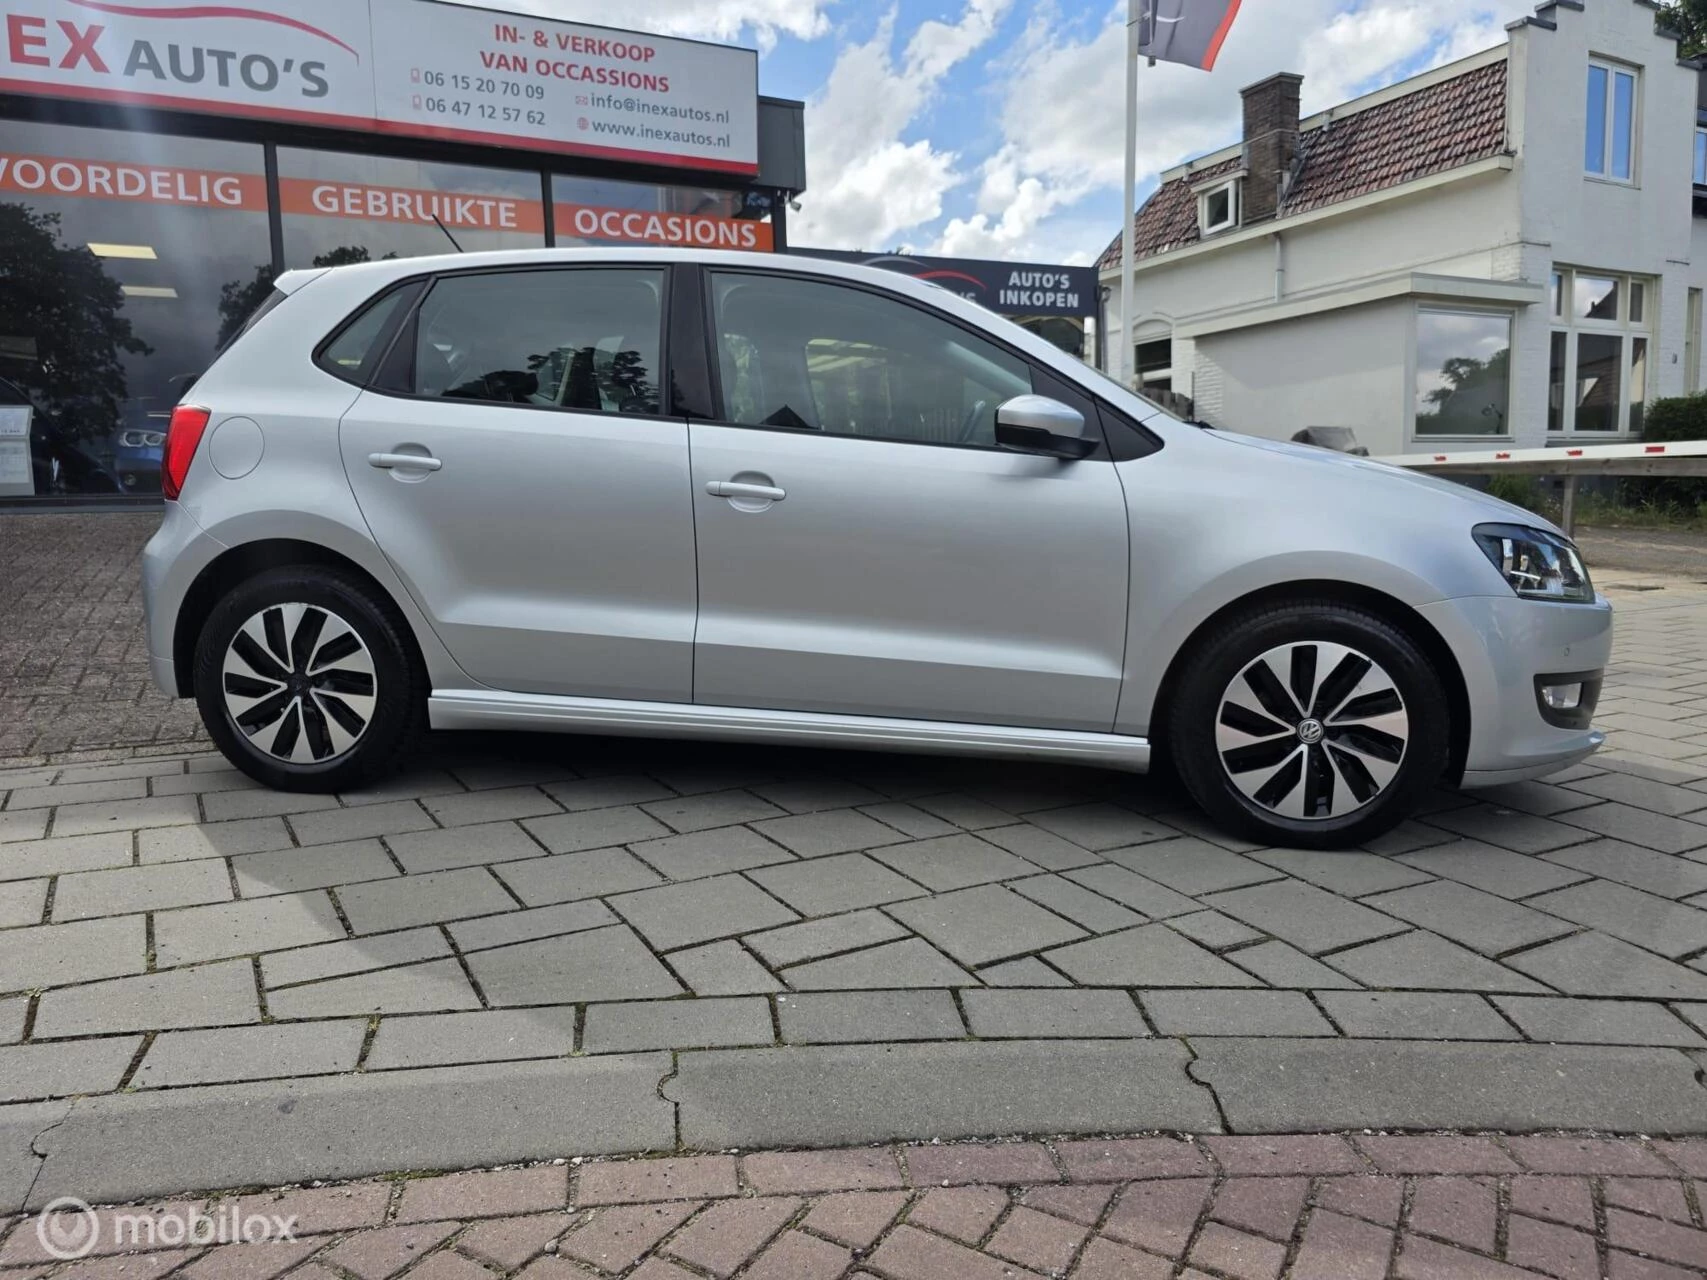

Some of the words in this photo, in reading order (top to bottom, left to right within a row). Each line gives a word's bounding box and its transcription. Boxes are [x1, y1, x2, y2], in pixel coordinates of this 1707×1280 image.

[494, 24, 525, 43] IN-
[533, 30, 548, 48] &
[556, 33, 656, 63] VERKOOP
[123, 39, 330, 98] AUTO'S
[480, 51, 528, 73] VAN
[535, 59, 670, 93] OCCASSIONS
[424, 70, 445, 87] 06
[451, 74, 470, 90] 15
[475, 78, 495, 94] 20
[500, 81, 520, 97] 70
[525, 84, 544, 100] 09
[426, 97, 446, 113] 06
[451, 101, 471, 116] 47
[478, 104, 497, 119] 12
[502, 107, 521, 122] 57
[526, 110, 546, 126] 62
[591, 93, 730, 124] info@inexautos.nl
[592, 120, 731, 148] www.inexautos.nl
[312, 185, 517, 228] GEBRUIKTE
[574, 208, 757, 248] OCCASIONS
[1009, 270, 1070, 290] AUTO'S
[999, 289, 1079, 308] INKOPEN
